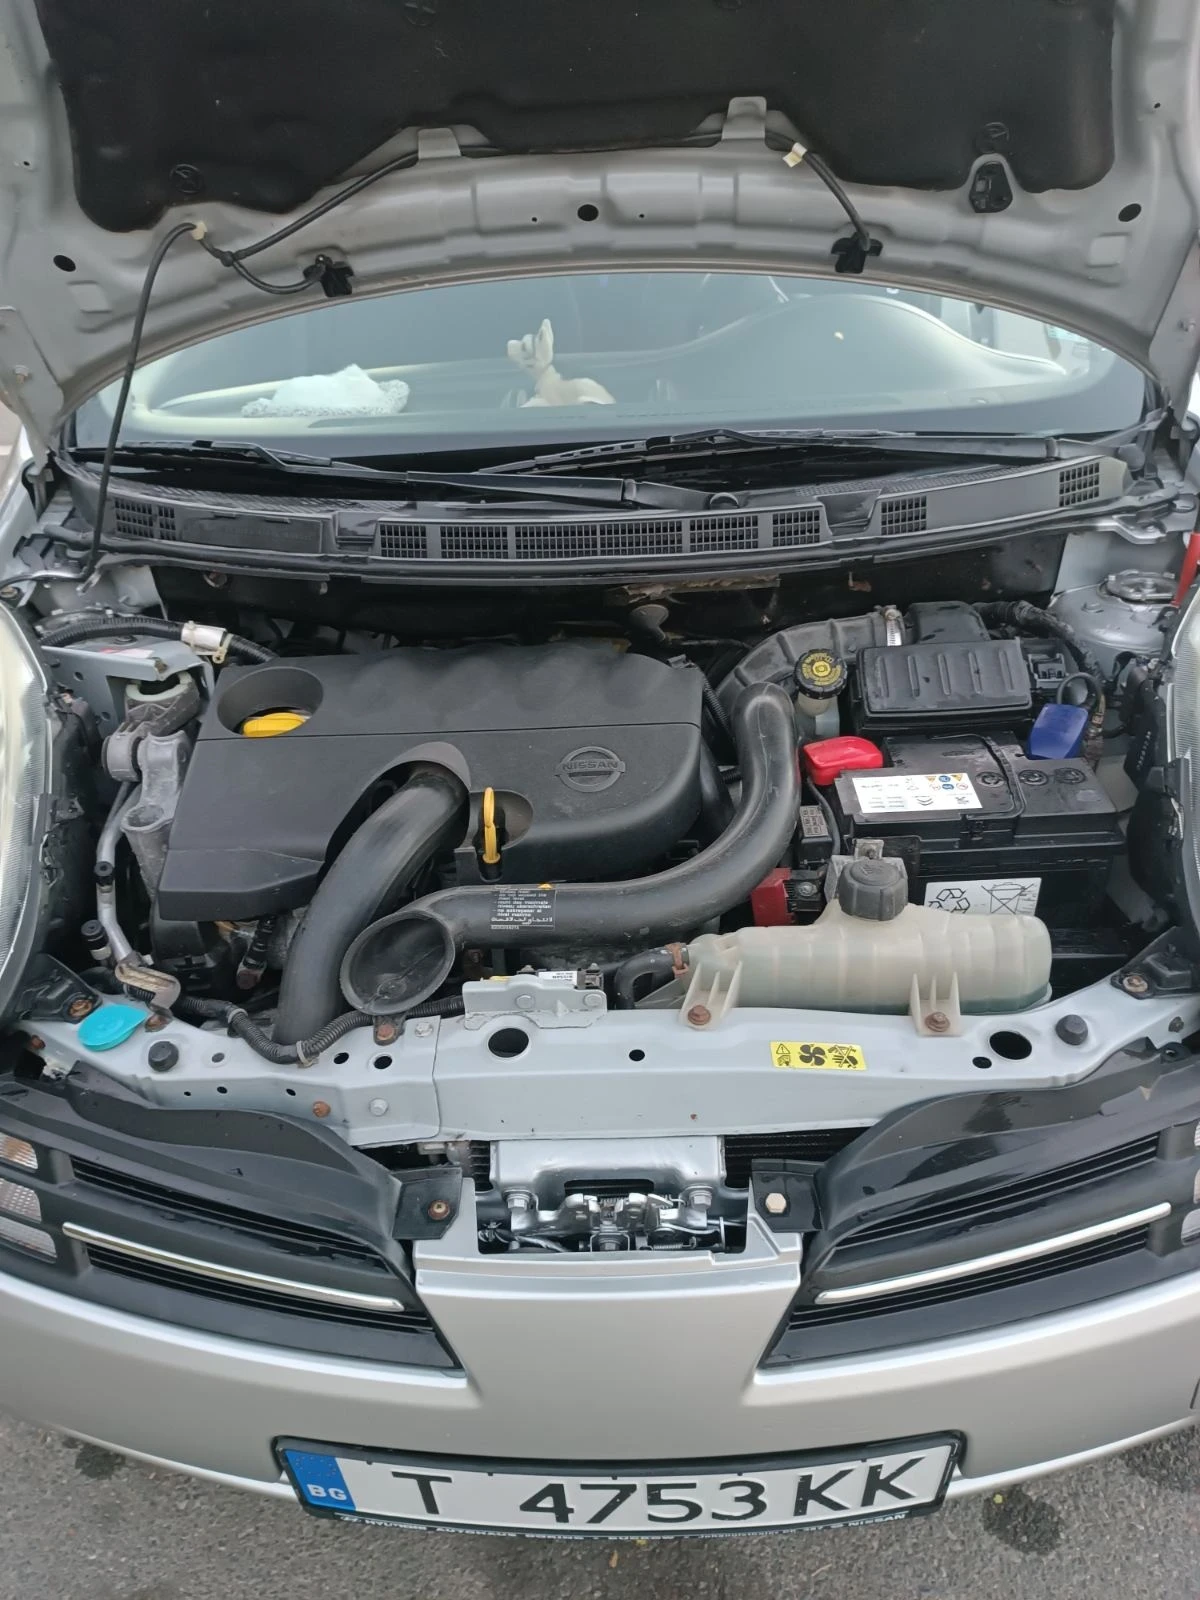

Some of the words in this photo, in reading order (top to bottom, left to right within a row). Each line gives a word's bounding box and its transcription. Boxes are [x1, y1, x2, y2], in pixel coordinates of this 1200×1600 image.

[563, 761, 618, 771] NISSAN
[308, 1483, 348, 1501] BG
[391, 1471, 452, 1515] T
[519, 1480, 768, 1524] 4753
[793, 1456, 926, 1517] KK
